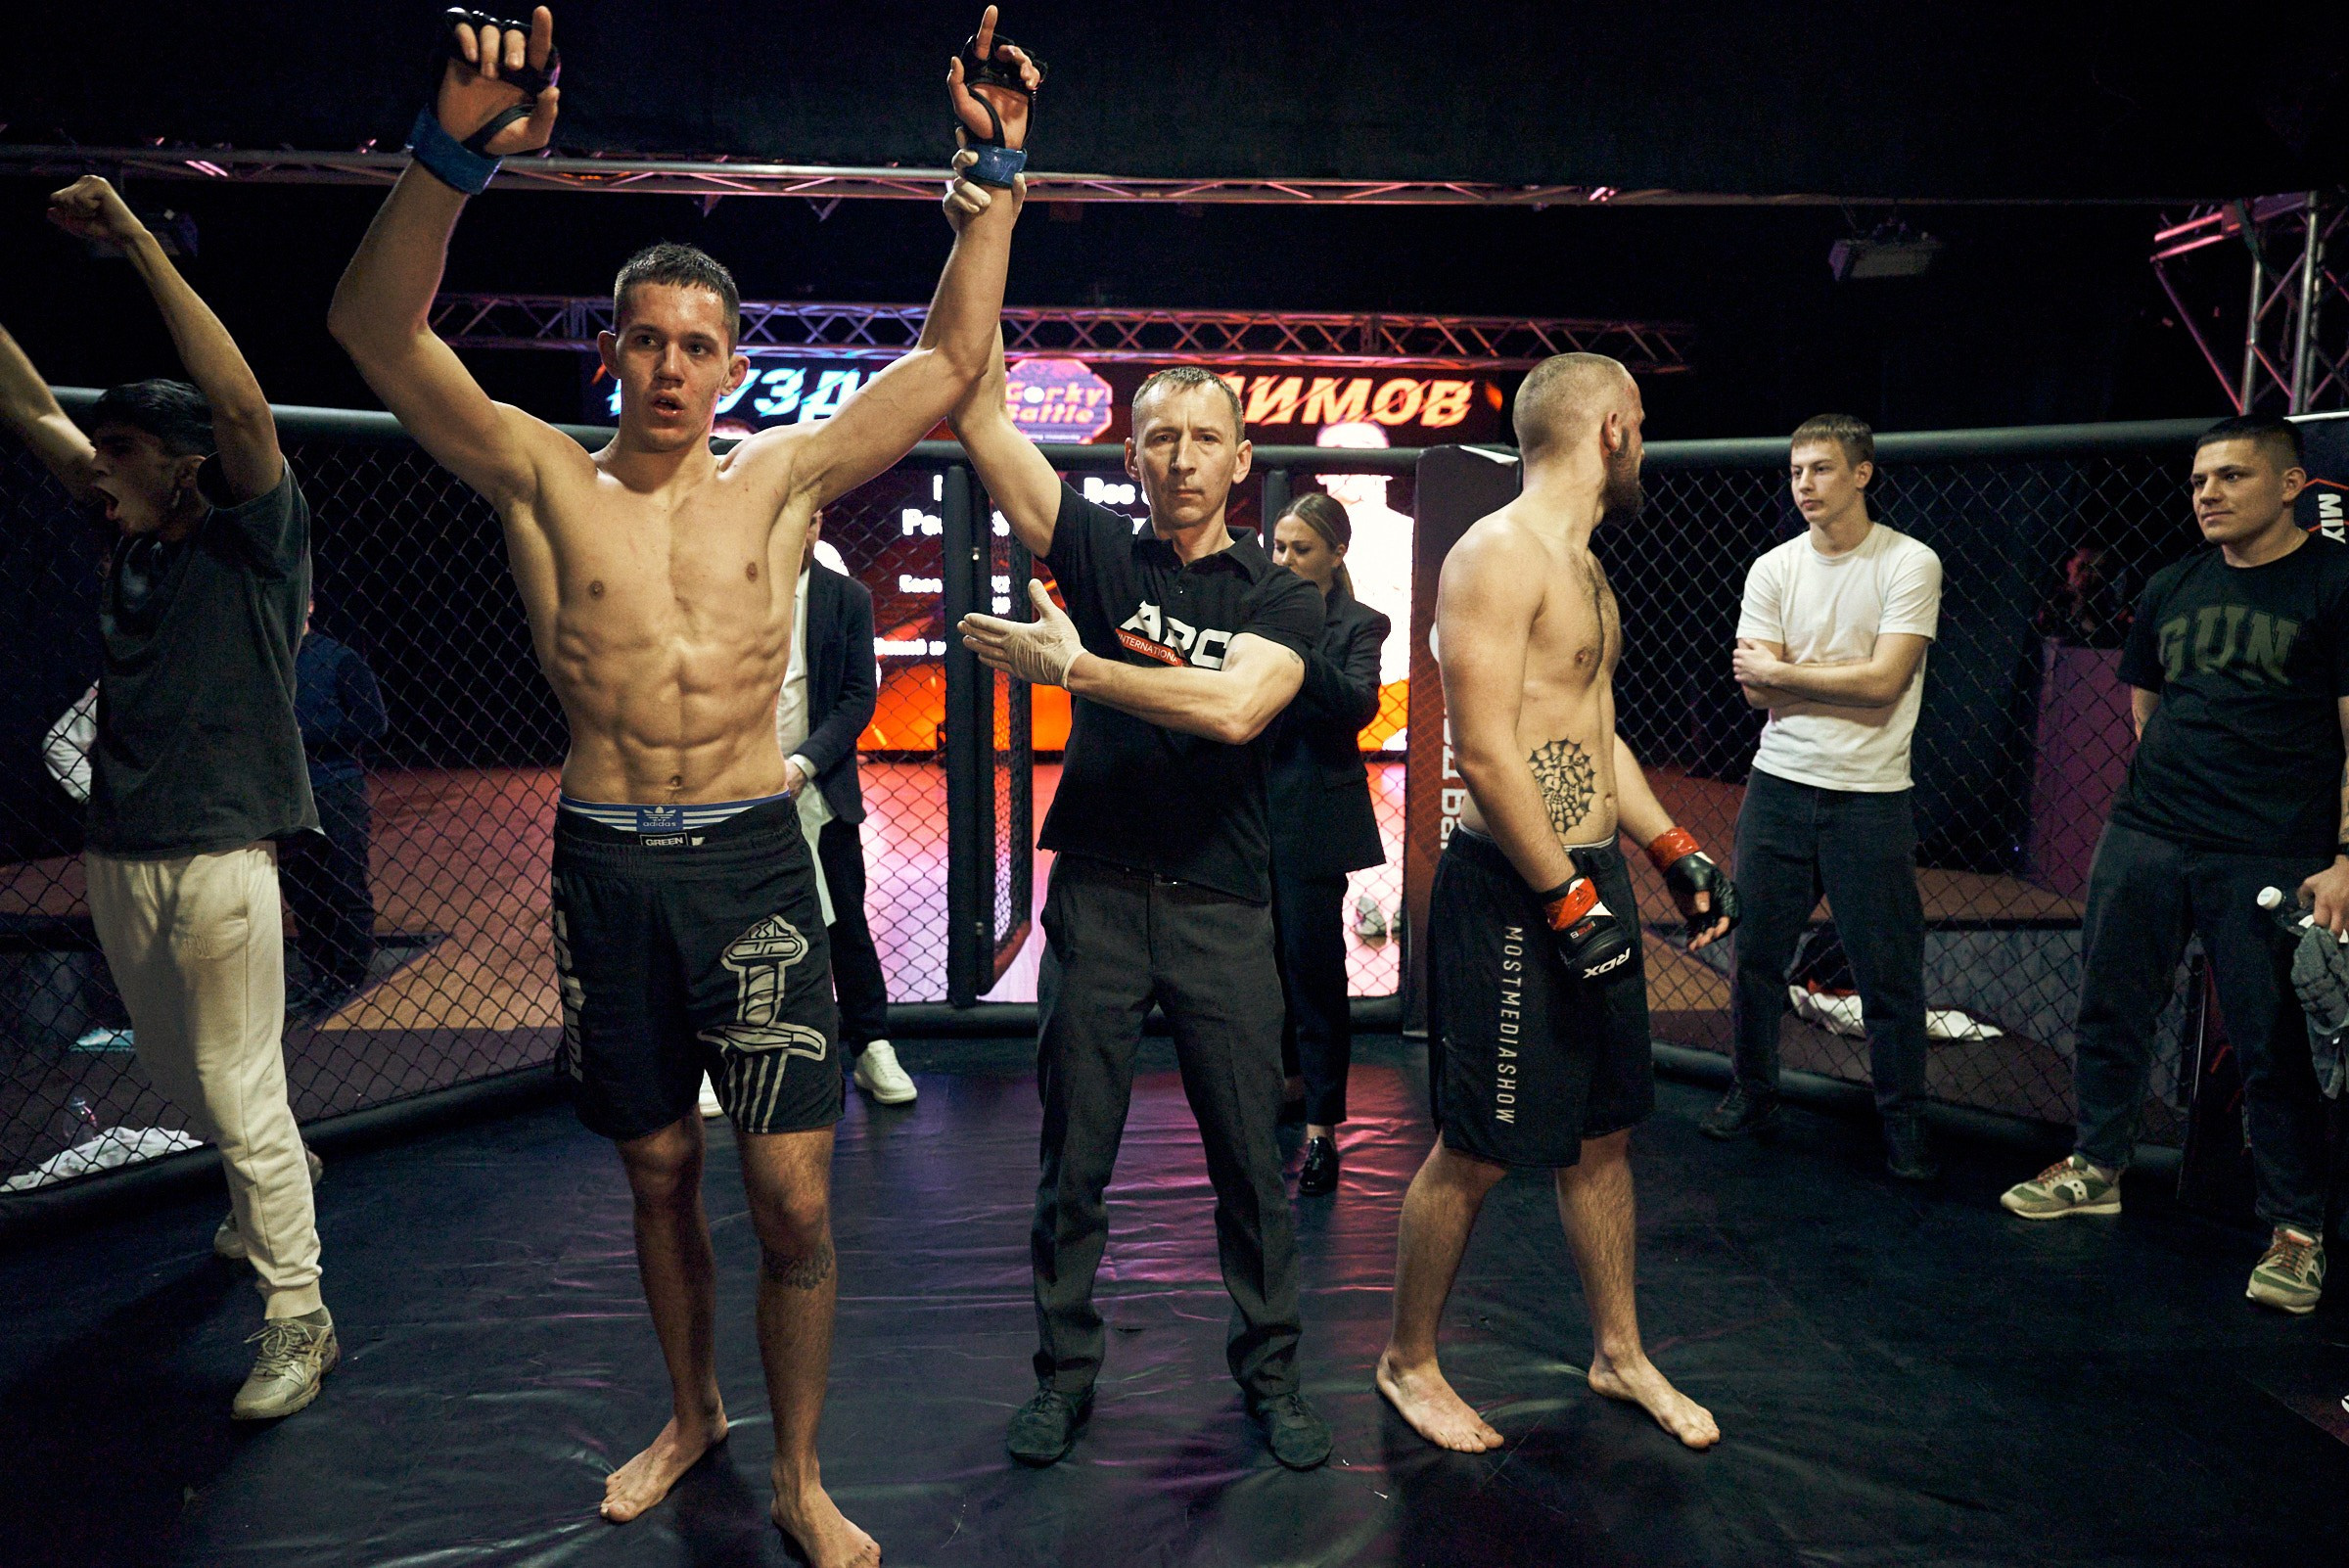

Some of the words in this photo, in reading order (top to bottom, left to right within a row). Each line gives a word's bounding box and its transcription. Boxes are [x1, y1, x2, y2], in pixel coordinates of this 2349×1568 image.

[1005, 381, 1105, 407] Gorky
[1220, 374, 1474, 428] ИМОВ
[1118, 633, 1180, 665] INTERNATIONA
[2159, 606, 2299, 685] GUN
[646, 837, 683, 846] GREEN
[1582, 947, 1631, 979] RDX
